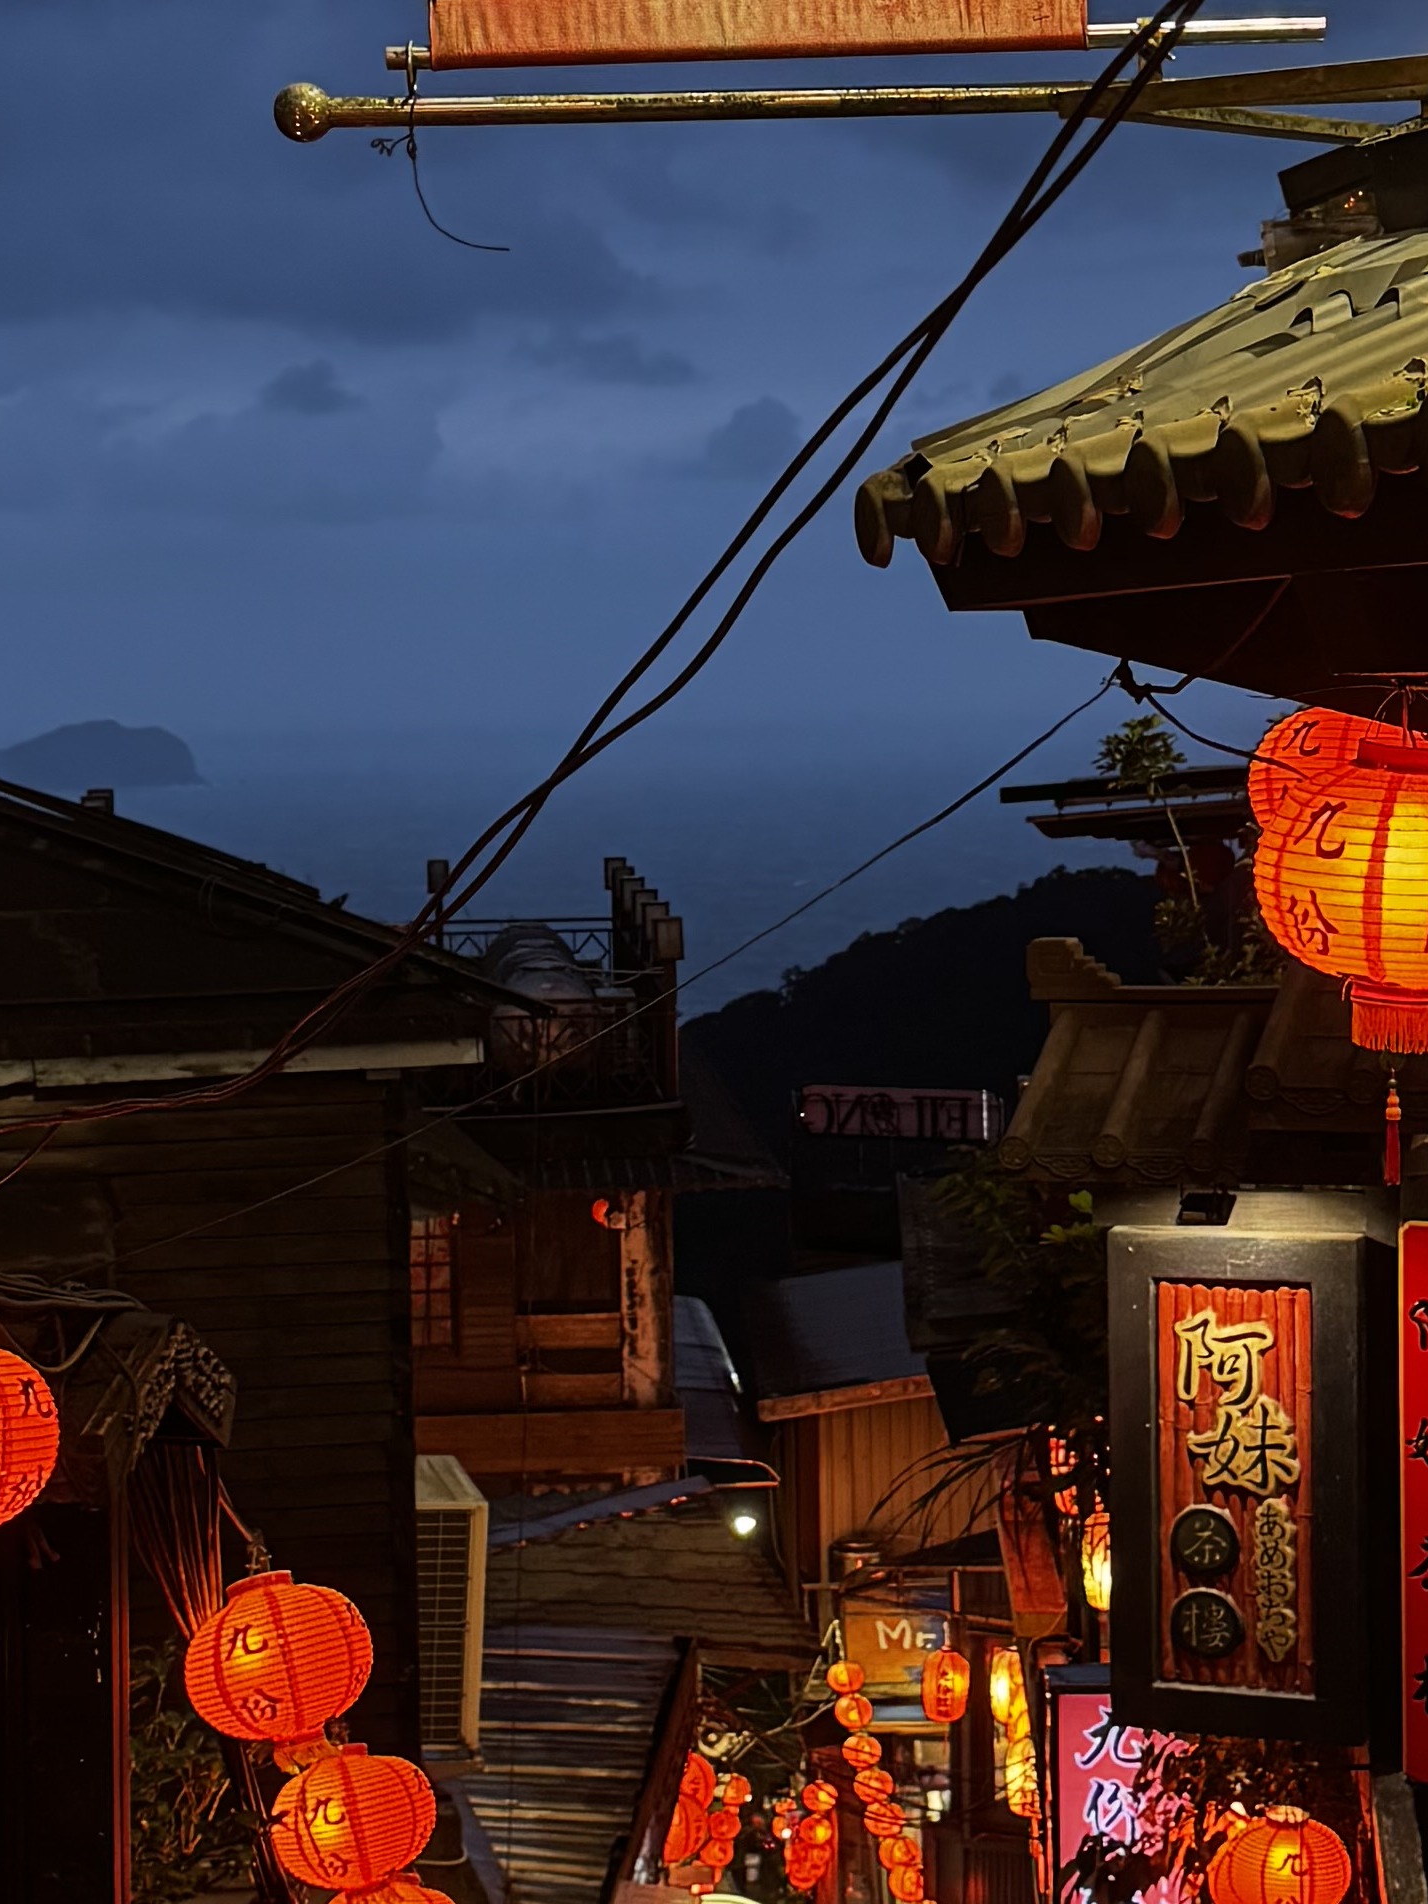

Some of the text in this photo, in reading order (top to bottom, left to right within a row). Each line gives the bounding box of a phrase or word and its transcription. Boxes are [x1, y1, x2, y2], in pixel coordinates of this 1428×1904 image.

[1287, 800, 1348, 956] 九份
[1178, 1312, 1296, 1490] 阿妹
[1182, 1519, 1232, 1648] 茶樓
[1258, 1502, 1289, 1661] あめおちゃ
[225, 1624, 283, 1723] 九份
